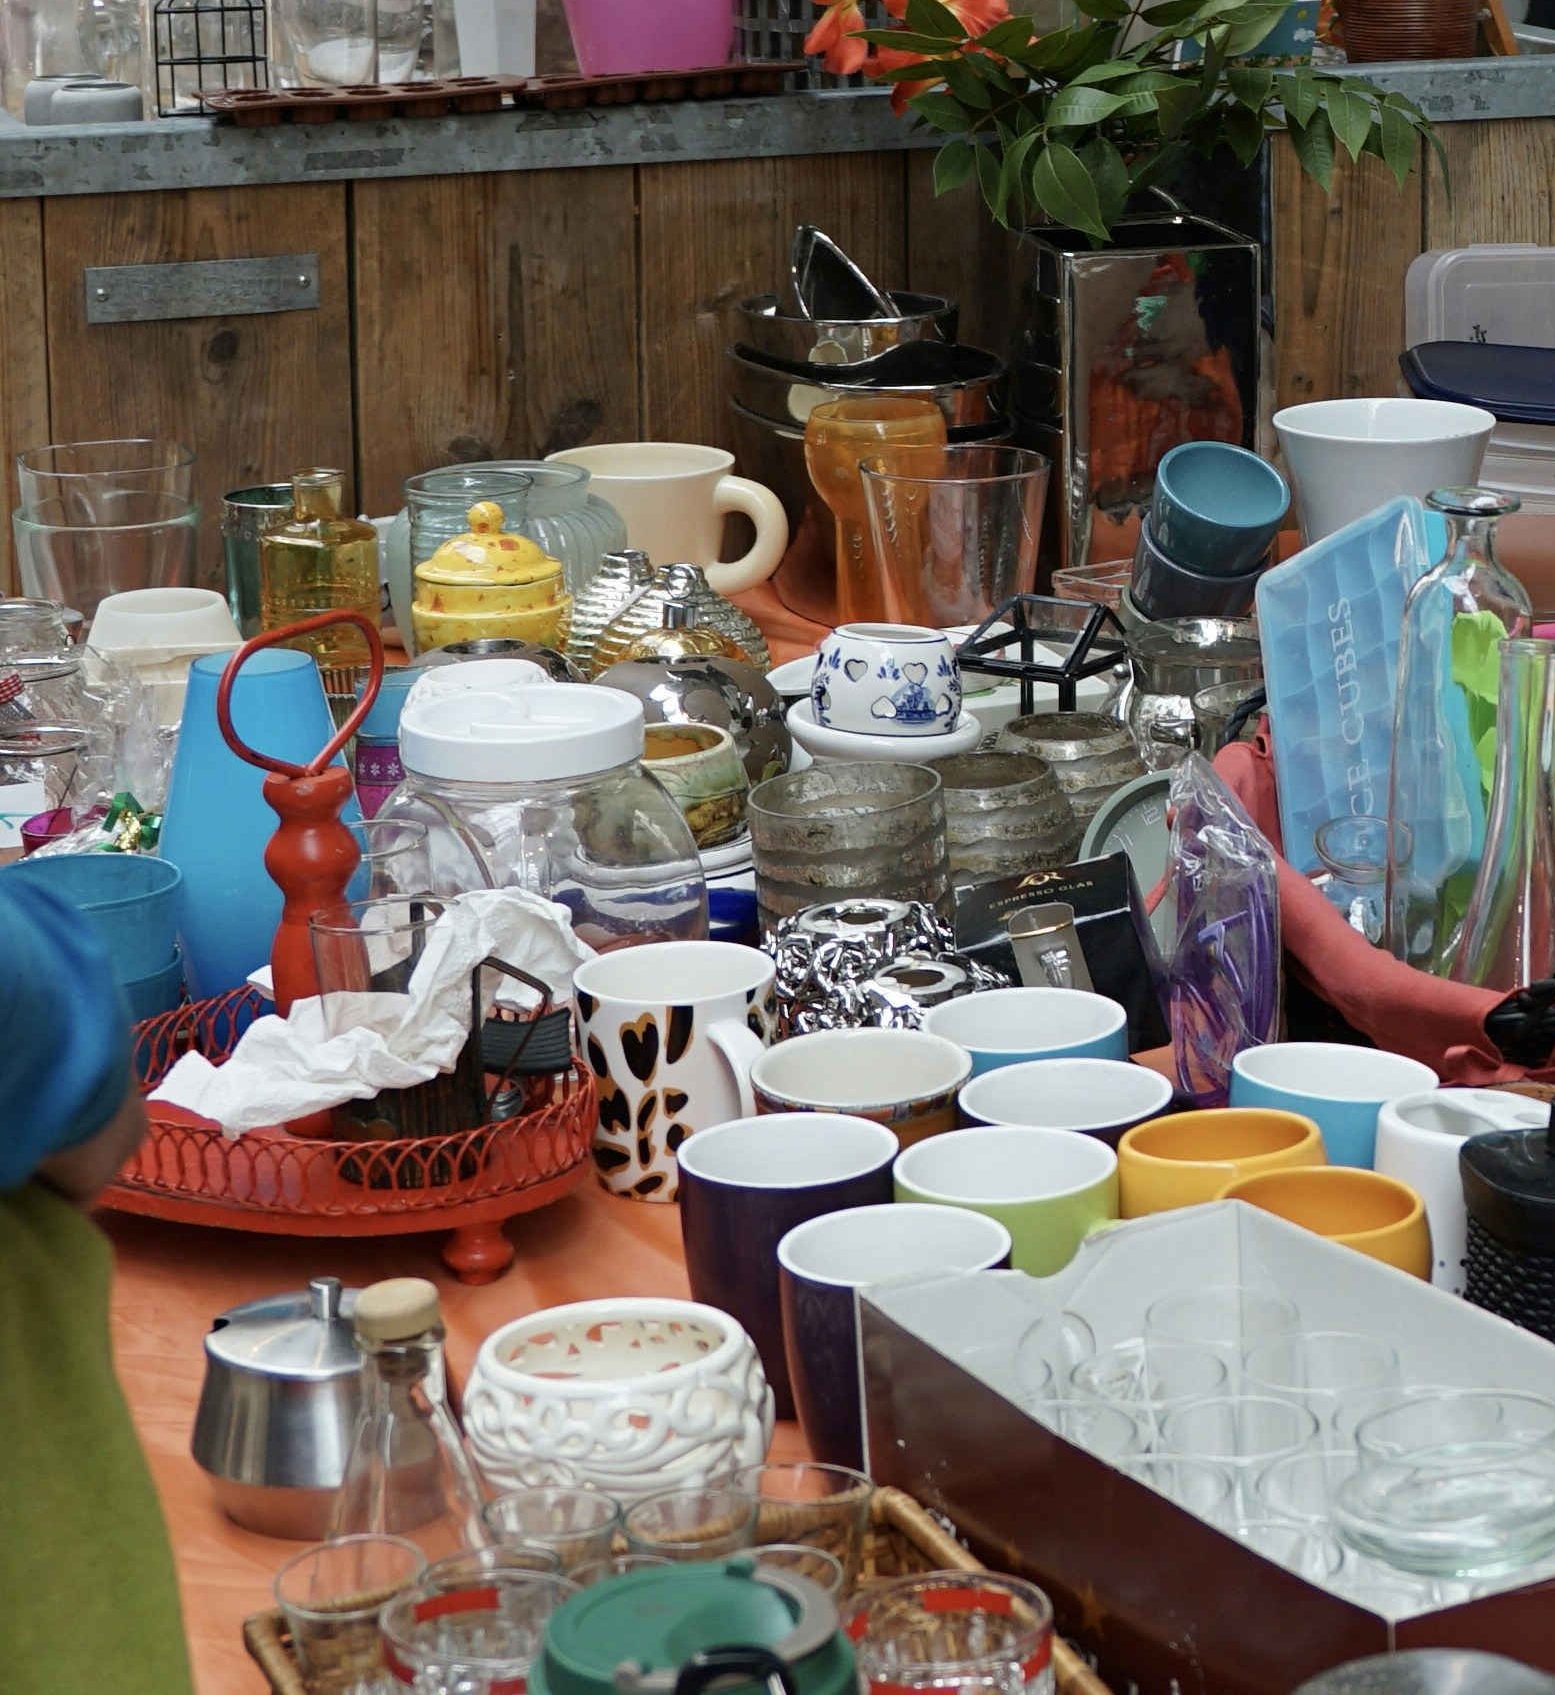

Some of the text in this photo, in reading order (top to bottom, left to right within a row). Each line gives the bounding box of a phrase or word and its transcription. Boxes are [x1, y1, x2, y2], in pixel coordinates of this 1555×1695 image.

[1328, 596, 1366, 746] CUBES
[988, 879, 1094, 910] ESPRESSO GLAS
